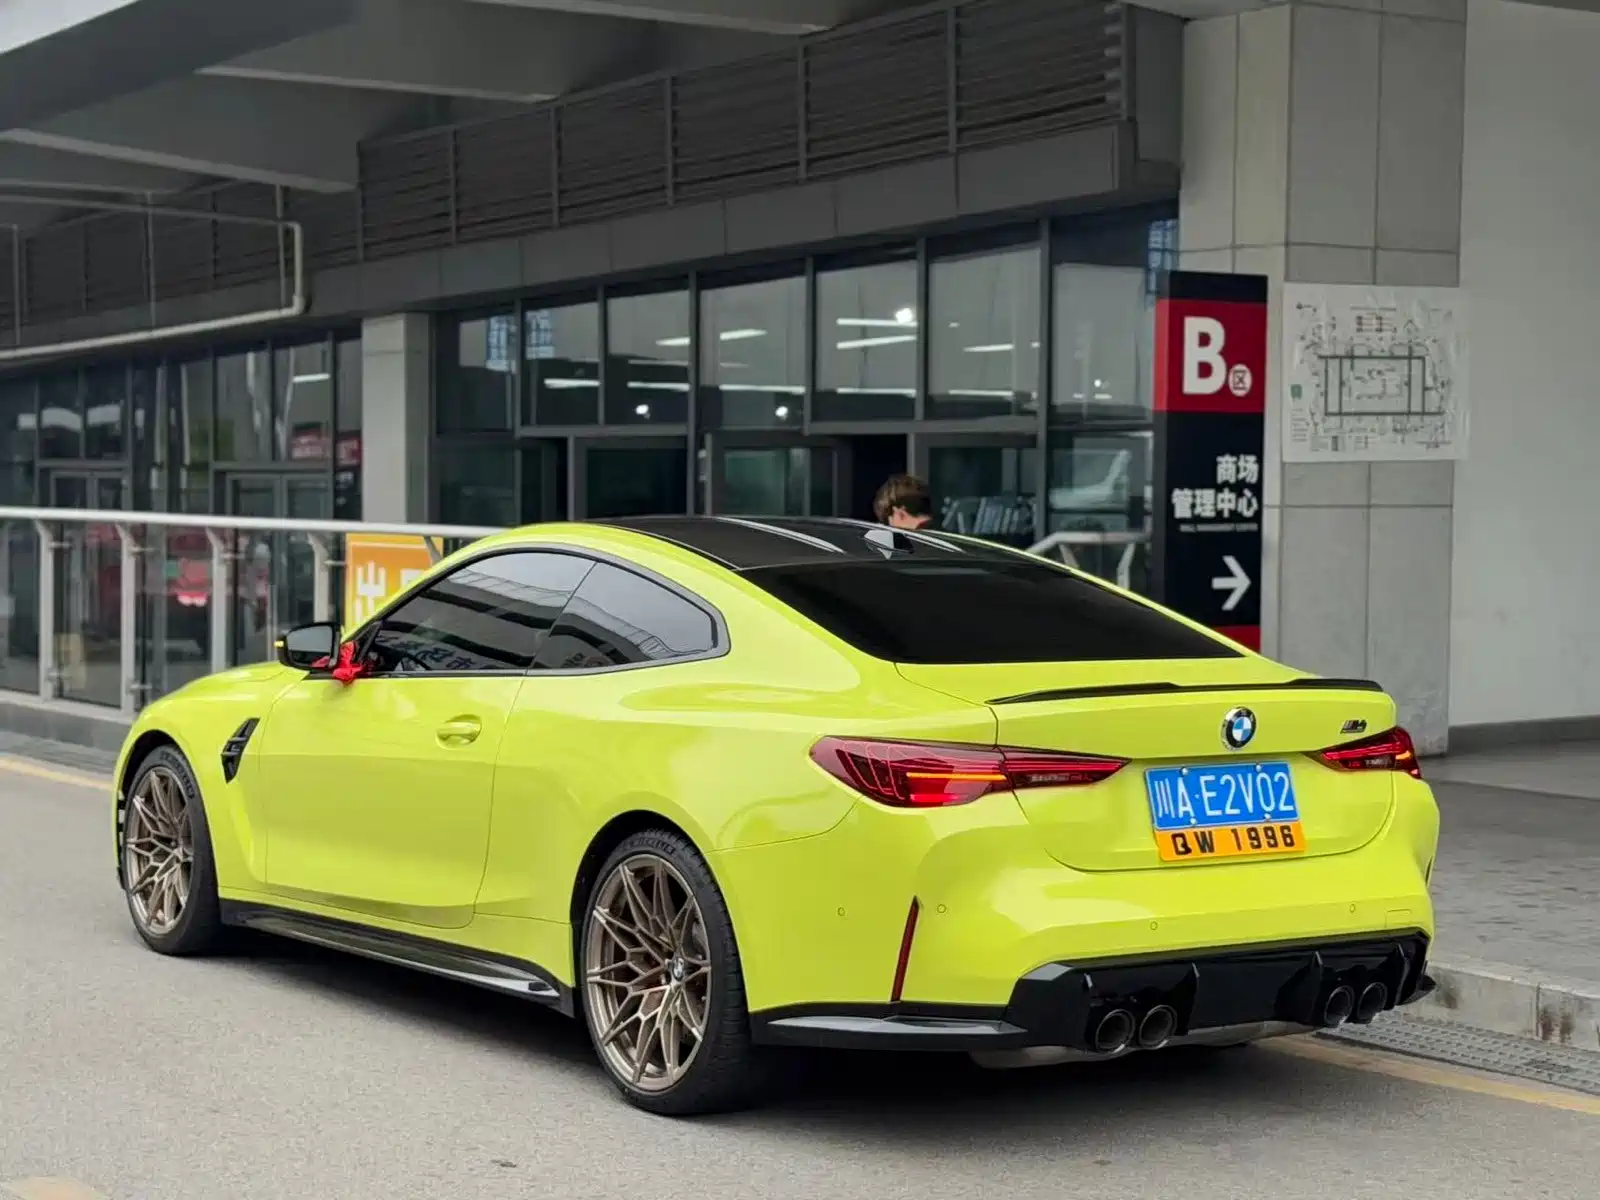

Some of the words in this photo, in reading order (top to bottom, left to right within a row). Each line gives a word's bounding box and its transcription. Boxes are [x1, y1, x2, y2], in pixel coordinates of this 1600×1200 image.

[1216, 453, 1259, 485] 商场
[1171, 487, 1259, 518] 管理中心
[1171, 830, 1215, 855] QW
[1231, 825, 1295, 851] 1996
